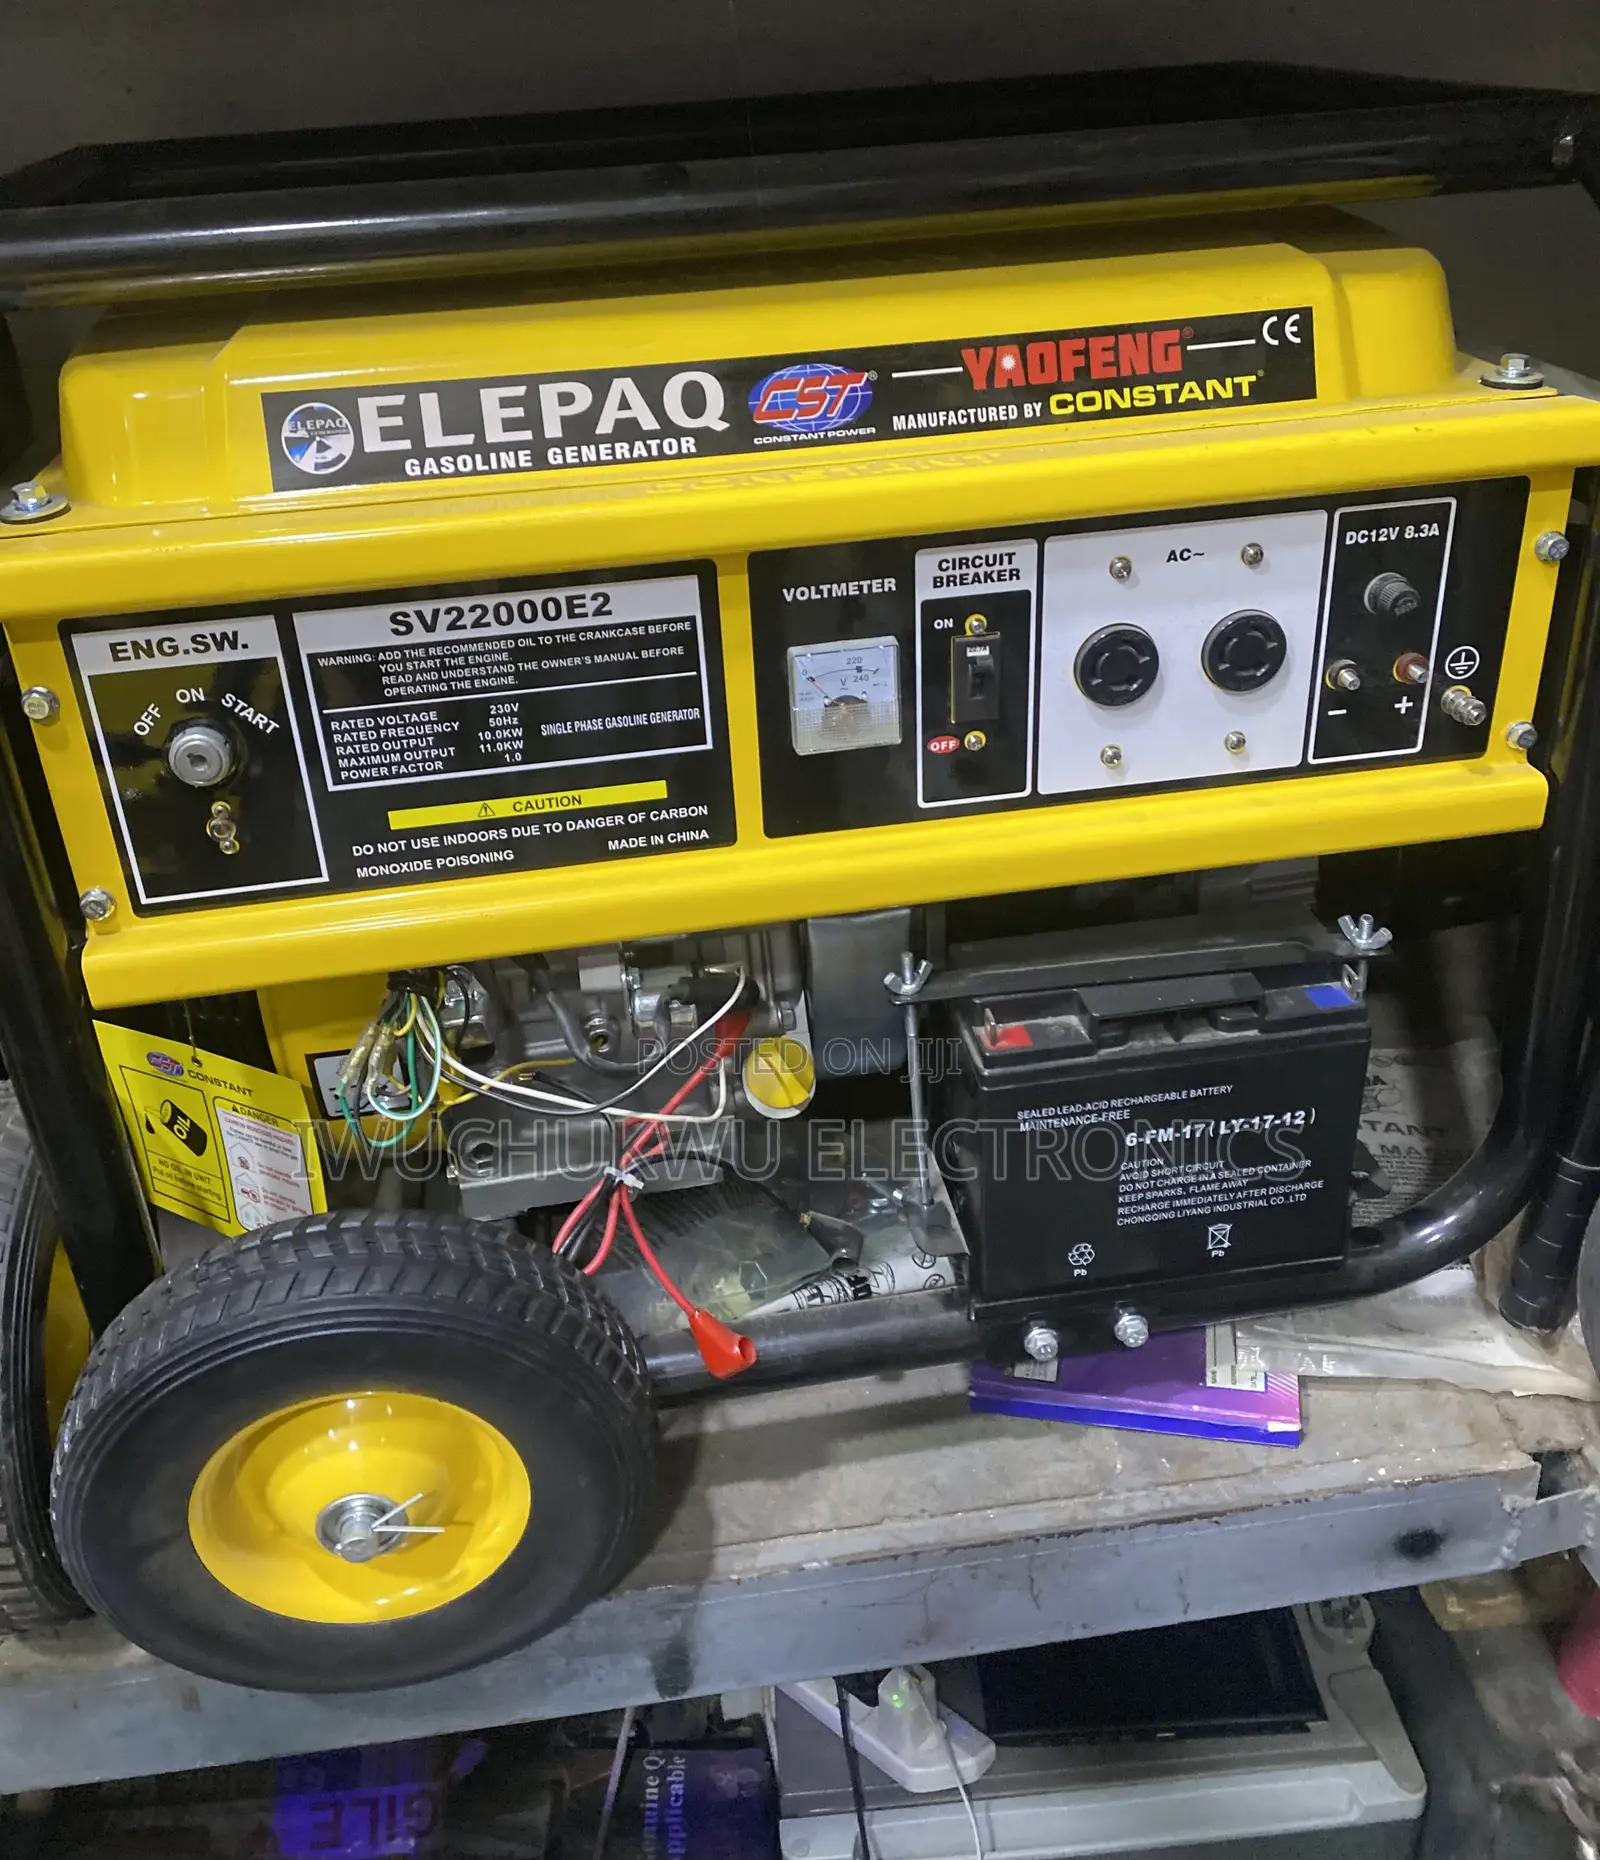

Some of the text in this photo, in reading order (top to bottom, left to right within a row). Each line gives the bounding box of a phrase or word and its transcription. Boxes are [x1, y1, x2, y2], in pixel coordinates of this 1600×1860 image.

[1262, 314, 1300, 345] CE
[753, 371, 868, 423] CST
[892, 374, 1257, 432] MANUFACTURED BY CONSTANT
[289, 416, 347, 432] ELEPAQ
[357, 370, 731, 453] ELEPAQ
[753, 426, 876, 445] CONSTANT POWER
[404, 435, 697, 477] GASOLINE GENERATOR
[1345, 521, 1440, 545] DC12V 8.3A
[937, 552, 1017, 572] CIRCUIT
[782, 577, 897, 602] VOLTMETER
[932, 568, 1021, 589] BREAKER
[389, 591, 613, 637] SV22000E2
[933, 618, 954, 630] ON
[108, 630, 249, 663] ENG.SW.
[317, 621, 692, 667] WARNING: ADD THE RECOMMENDED OIL TO THE CRANKCASE BEFORE
[379, 652, 513, 674] YOU START THE ENGINE.
[381, 646, 684, 685] READ AND UNDERSTAND THE OWNER'S MANUAL BEFORE
[846, 656, 863, 665] 220
[383, 675, 519, 697] OPERATING THE ENGINE.
[853, 673, 870, 683] 240
[175, 687, 205, 704] ON
[133, 702, 162, 737] OFF
[221, 692, 280, 735] START
[330, 702, 519, 731] RATED VOLTAGE 230V
[540, 707, 701, 737] SINGLE PHASE GASOLINE GENERATOR
[332, 715, 519, 744] RATED FREQUENCY 50Hz
[335, 727, 523, 756] RATED OUTPUT 10.0KW
[338, 740, 524, 769] MAXIMUM OUTPUT 11.0KW
[930, 739, 956, 751] OFF
[340, 752, 522, 781] POWER FACTOR 1.0
[512, 794, 582, 813] CAUTION
[352, 804, 709, 857] DO NOT USE INDOORS DUE TO DANGER OF CARBON
[355, 829, 710, 878] MONOXIDE POISONING MADE IN CHINA
[187, 1069, 254, 1097] CONSTANT
[239, 1105, 279, 1127] DANGER
[1016, 1084, 1234, 1120] SEALED LEAD-ACID RECHARGEABLE BATTERY
[173, 1118, 191, 1140] OIL
[1020, 1109, 1131, 1133] MAINTENANCE-FREE
[1118, 1182, 1133, 1193] DO
[1135, 1179, 1156, 1191] NOT
[1157, 1175, 1197, 1188] CHARGE
[1217, 1167, 1256, 1179] SEALED
[1257, 1159, 1312, 1174] CONTAINER
[1119, 1160, 1225, 1182] AVOID SHORT CIRCUIT
[1120, 1157, 1164, 1171] CAUTION
[1117, 1180, 1324, 1216] RECHARGE IMMEDIATELY AFTER DISCHARGE
[1118, 1193, 1144, 1204] KEEP
[1189, 1183, 1221, 1193] FLAME
[1221, 1179, 1249, 1189] AWAY
[1116, 1211, 1176, 1227] CHONGQING
[1177, 1206, 1211, 1218] LIYANG
[1213, 1198, 1269, 1213] INDUSTRIAL
[1211, 1249, 1225, 1258] Pb
[1073, 1268, 1088, 1277] Pb
